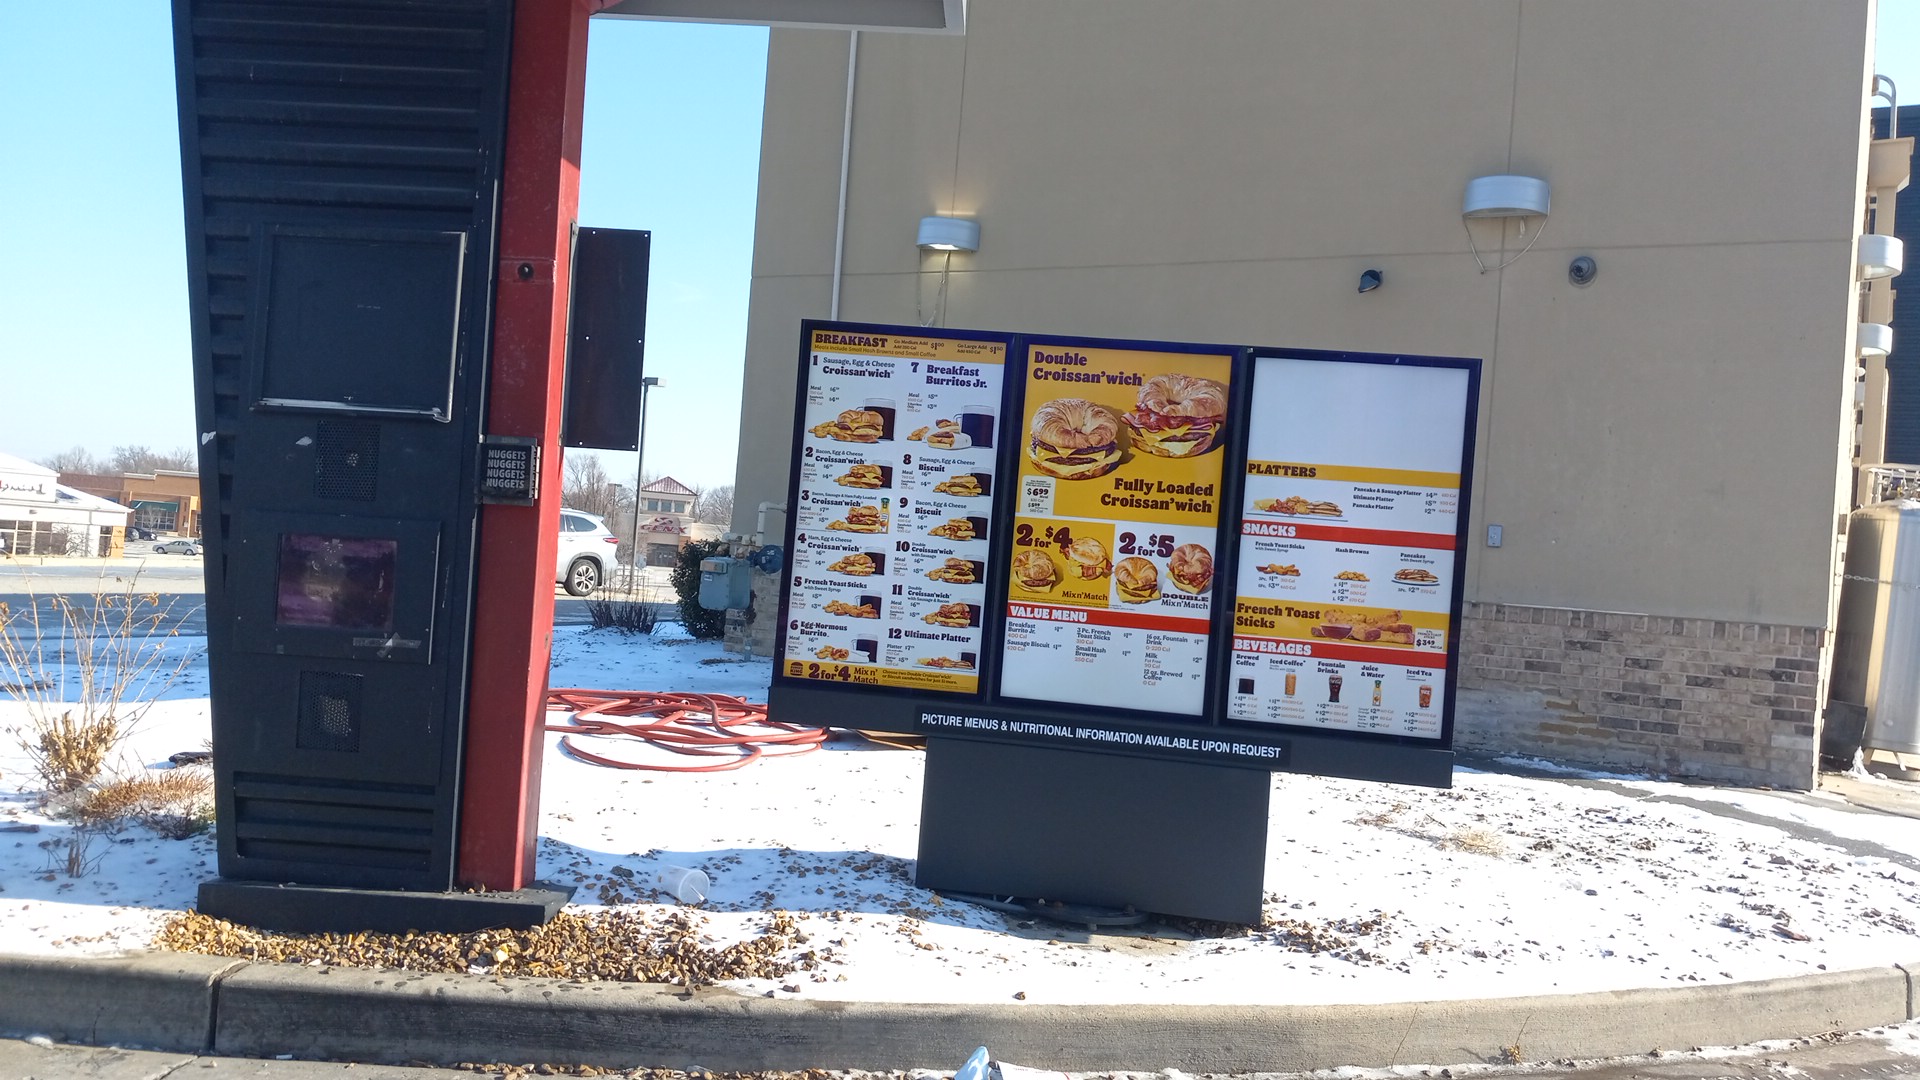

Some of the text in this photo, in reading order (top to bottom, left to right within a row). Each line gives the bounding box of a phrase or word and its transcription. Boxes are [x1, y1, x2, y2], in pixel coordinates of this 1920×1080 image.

[815, 333, 888, 348] BREAKFAST
[813, 355, 818, 366] 1
[823, 357, 851, 366] Sausage,
[852, 359, 865, 367] Egg
[871, 360, 895, 368] Cheese
[1034, 351, 1087, 367] Double
[910, 361, 919, 373] 7
[926, 364, 980, 377] Breakfast
[926, 376, 987, 388] Burritos Jr.
[1033, 367, 1142, 387] Croissan'wich
[488, 450, 527, 460] NUGGETS
[805, 446, 814, 457] 2
[488, 459, 526, 470] NUGGETS
[903, 454, 912, 465] 8
[919, 456, 941, 464] Sausage,
[918, 464, 945, 472] Biscuit
[1248, 463, 1317, 478] PLATTERS
[487, 469, 525, 479] NUGGETS
[486, 478, 525, 488] NUGGETS
[1114, 477, 1214, 497] Fully Loaded
[801, 490, 810, 501] 3
[899, 497, 909, 508] 9
[1100, 493, 1212, 513] Croissan'wich
[915, 507, 942, 516] Biscuit
[1242, 523, 1296, 537] SNACKS
[797, 533, 807, 544] 4
[1016, 524, 1073, 550] 2 for $4
[896, 540, 910, 552] 10
[1119, 532, 1175, 558] 2 for $5
[794, 576, 802, 587] 5
[847, 581, 867, 589] Sticks
[892, 584, 903, 596] 11
[1162, 593, 1209, 602] DOUBLE
[1010, 605, 1088, 622] VALUE MENU
[1237, 603, 1321, 619] French Toast
[790, 619, 799, 630] 6
[800, 621, 848, 631] Egg-Normous
[1008, 621, 1036, 629] Breakfast
[1236, 616, 1275, 629] Sticks
[888, 628, 902, 640] 12
[904, 630, 971, 643] Ultimate Platter
[1091, 628, 1111, 636] French
[1007, 639, 1050, 649] Sausage Biscuit
[1162, 635, 1188, 643] Fountain
[1416, 639, 1435, 647] $349
[1233, 639, 1312, 656] BEVERAGES
[1317, 661, 1346, 669] Fountain
[808, 662, 851, 681] 2 for $4
[854, 667, 878, 676] Mix n'
[1160, 670, 1183, 678] Brewed
[853, 676, 879, 684] Match
[921, 712, 1281, 758] PICTURE MENUS & NUTRITIONAL INFORMATION AVAILABLE UPON REQUEST
